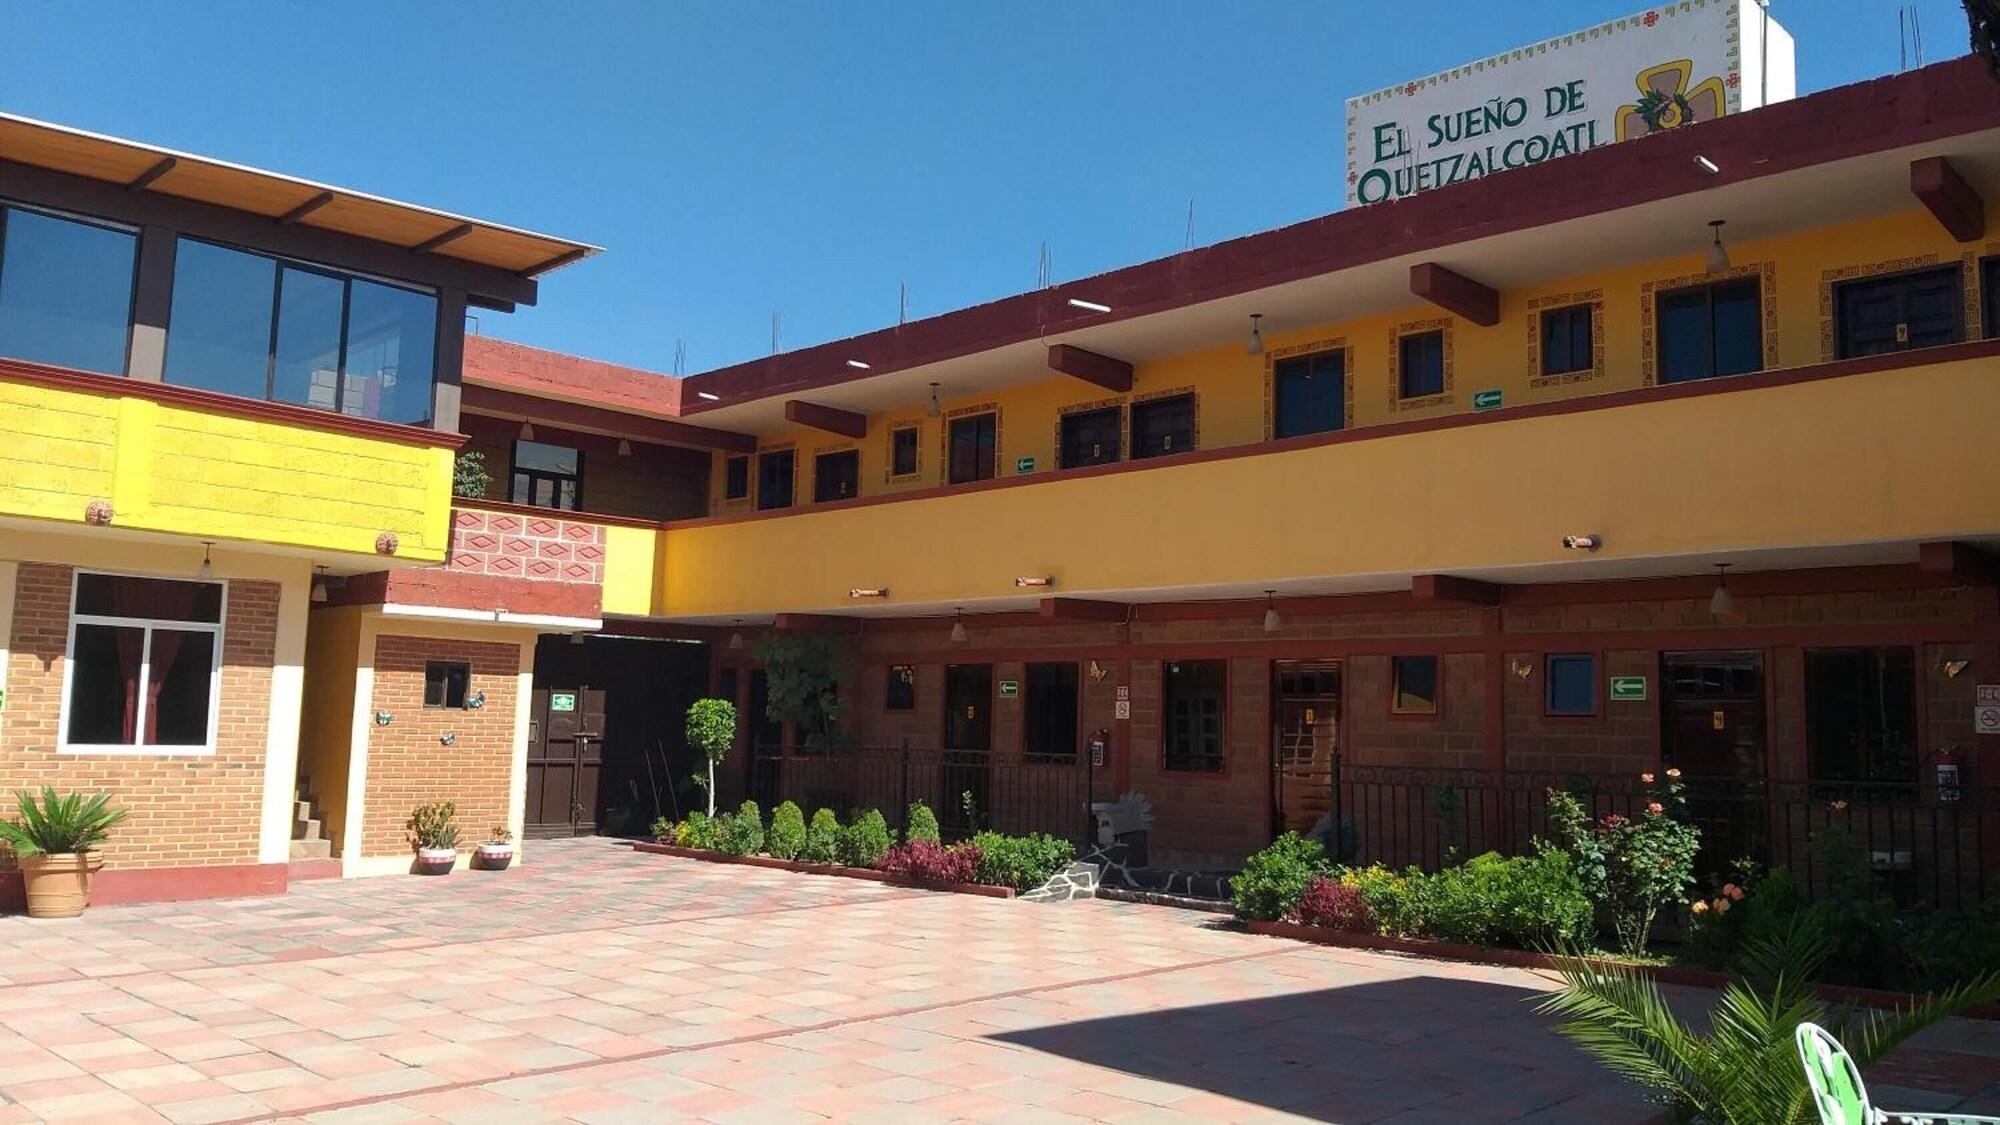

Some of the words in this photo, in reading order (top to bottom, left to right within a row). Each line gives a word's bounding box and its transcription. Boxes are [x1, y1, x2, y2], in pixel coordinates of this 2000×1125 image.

[1427, 95, 1527, 149] SUEÑO
[1544, 79, 1585, 118] DE
[1357, 119, 1607, 204] QUETZALCOATL
